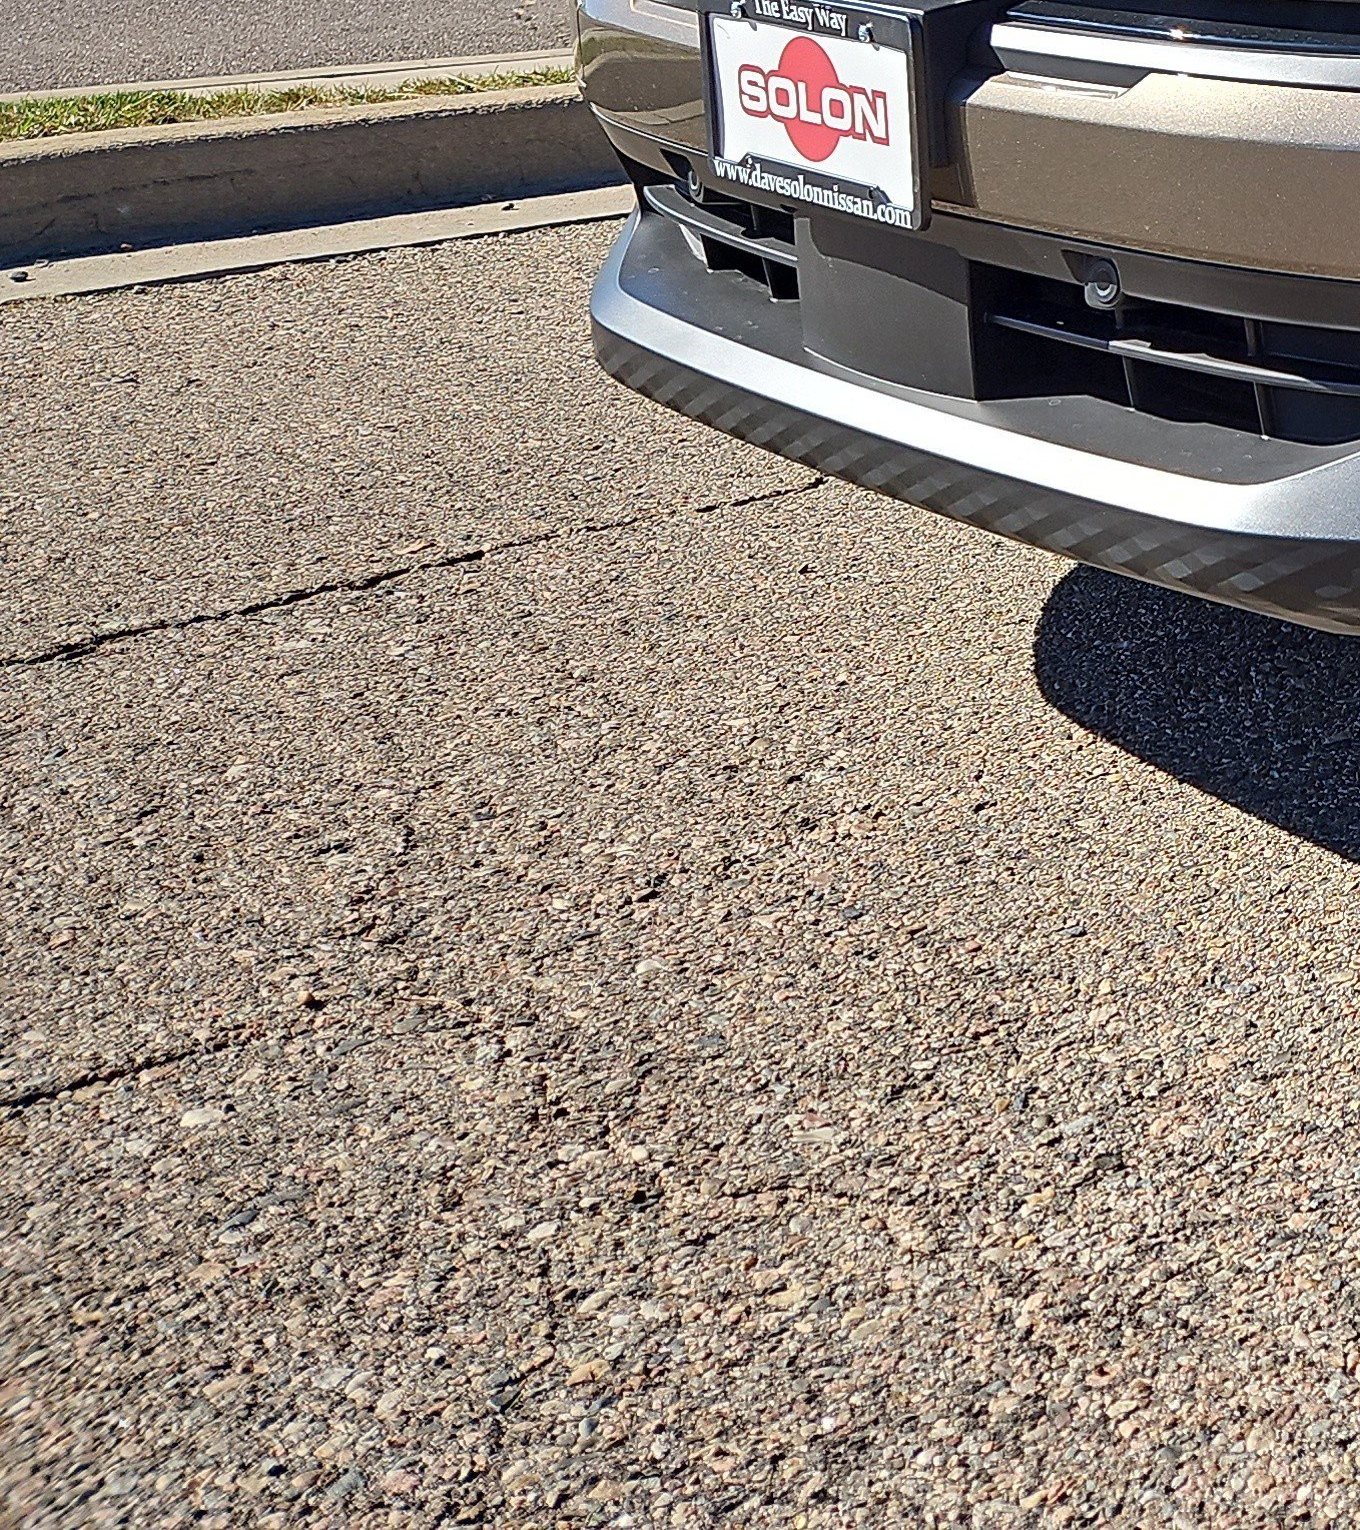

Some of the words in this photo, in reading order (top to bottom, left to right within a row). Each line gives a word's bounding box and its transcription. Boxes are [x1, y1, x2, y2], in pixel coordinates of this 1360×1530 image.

[813, 3, 847, 37] Way
[739, 68, 888, 141] SOLON
[713, 159, 913, 229] www.davesolonnissan.com
